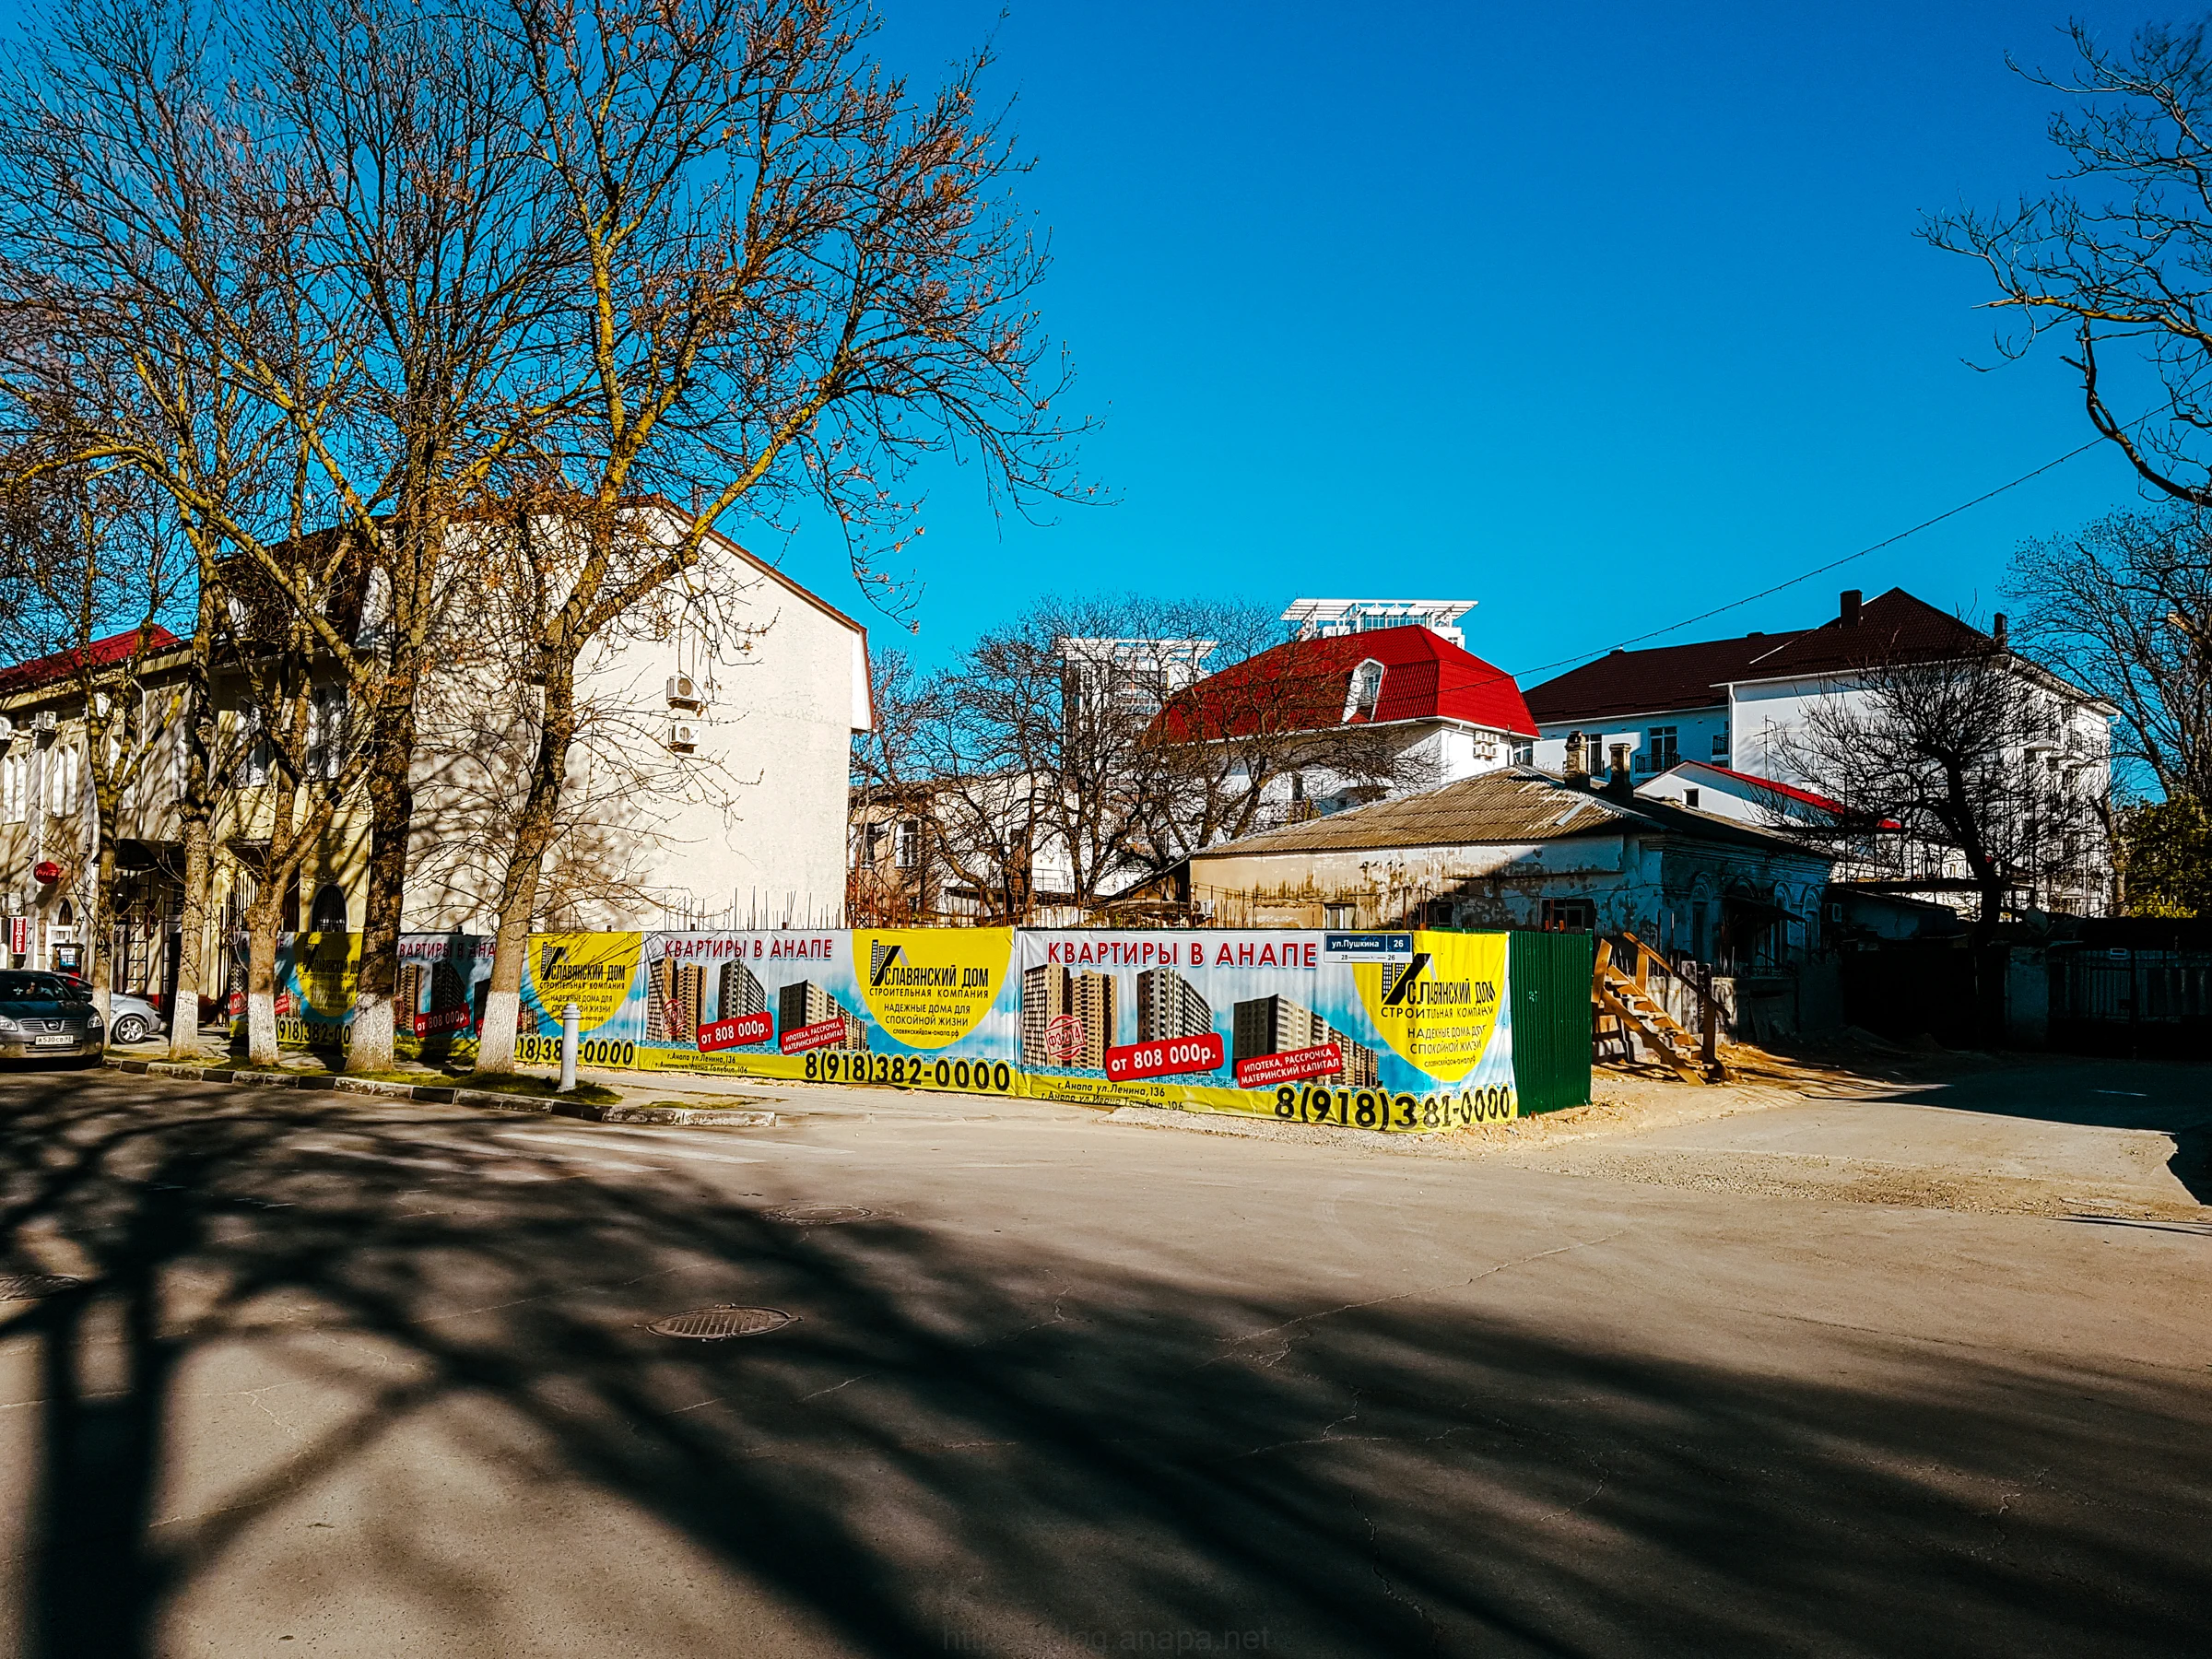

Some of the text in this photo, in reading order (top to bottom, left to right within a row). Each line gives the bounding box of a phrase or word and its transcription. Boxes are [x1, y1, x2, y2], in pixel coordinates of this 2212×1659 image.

[399, 943, 497, 959] ВАРТИРЫ В АНА
[665, 938, 833, 959] КВАРТИРЫ В АНАПЕ
[1331, 939, 1404, 949] ул.Пушкина 26
[1048, 942, 1317, 968] КВАРТИРЫ В АНАПЕ
[550, 961, 626, 982] СЛАВЯНСКИЙ ДОМ
[884, 964, 989, 989] СЛАВЯНСКИЙ ДОМ
[539, 982, 586, 990] СТРОИТЕЛЬНАЯ
[869, 987, 989, 999] СТРОИТЕЛЬНАЯ КОМПАНИЯ
[1475, 981, 1496, 1006] ДОМ
[550, 994, 582, 1003] НАДЕЖНЫЕ
[884, 1003, 971, 1016] НАДЕЖНЫЕ ДОМА ДЛЯ
[418, 1022, 426, 1031] от
[428, 1014, 442, 1029] 808
[885, 1014, 969, 1027] СПОКОЙНОЙ ЖИЗНИ
[700, 1019, 769, 1044] от 808 000р.
[783, 1029, 844, 1053] МАТЕРИНСКИЙ КАПИТАЛ
[785, 1022, 841, 1043] ИПОТЕКА, РАССРОЧКА,
[1451, 1027, 1471, 1041] ДОМА
[1111, 1043, 1217, 1072] от 808 000р.
[1244, 1047, 1335, 1073] ИПОТЕКА, РАССРОЧКА,
[805, 1052, 1011, 1092] 8(918)382-0000
[1241, 1058, 1339, 1086] МАТЕРИНСКИЙ КАПИТАЛ
[1057, 1080, 1166, 1098] г.Анапа ул.Ленина,136
[1275, 1086, 1511, 1131] 8(918)381-0000
